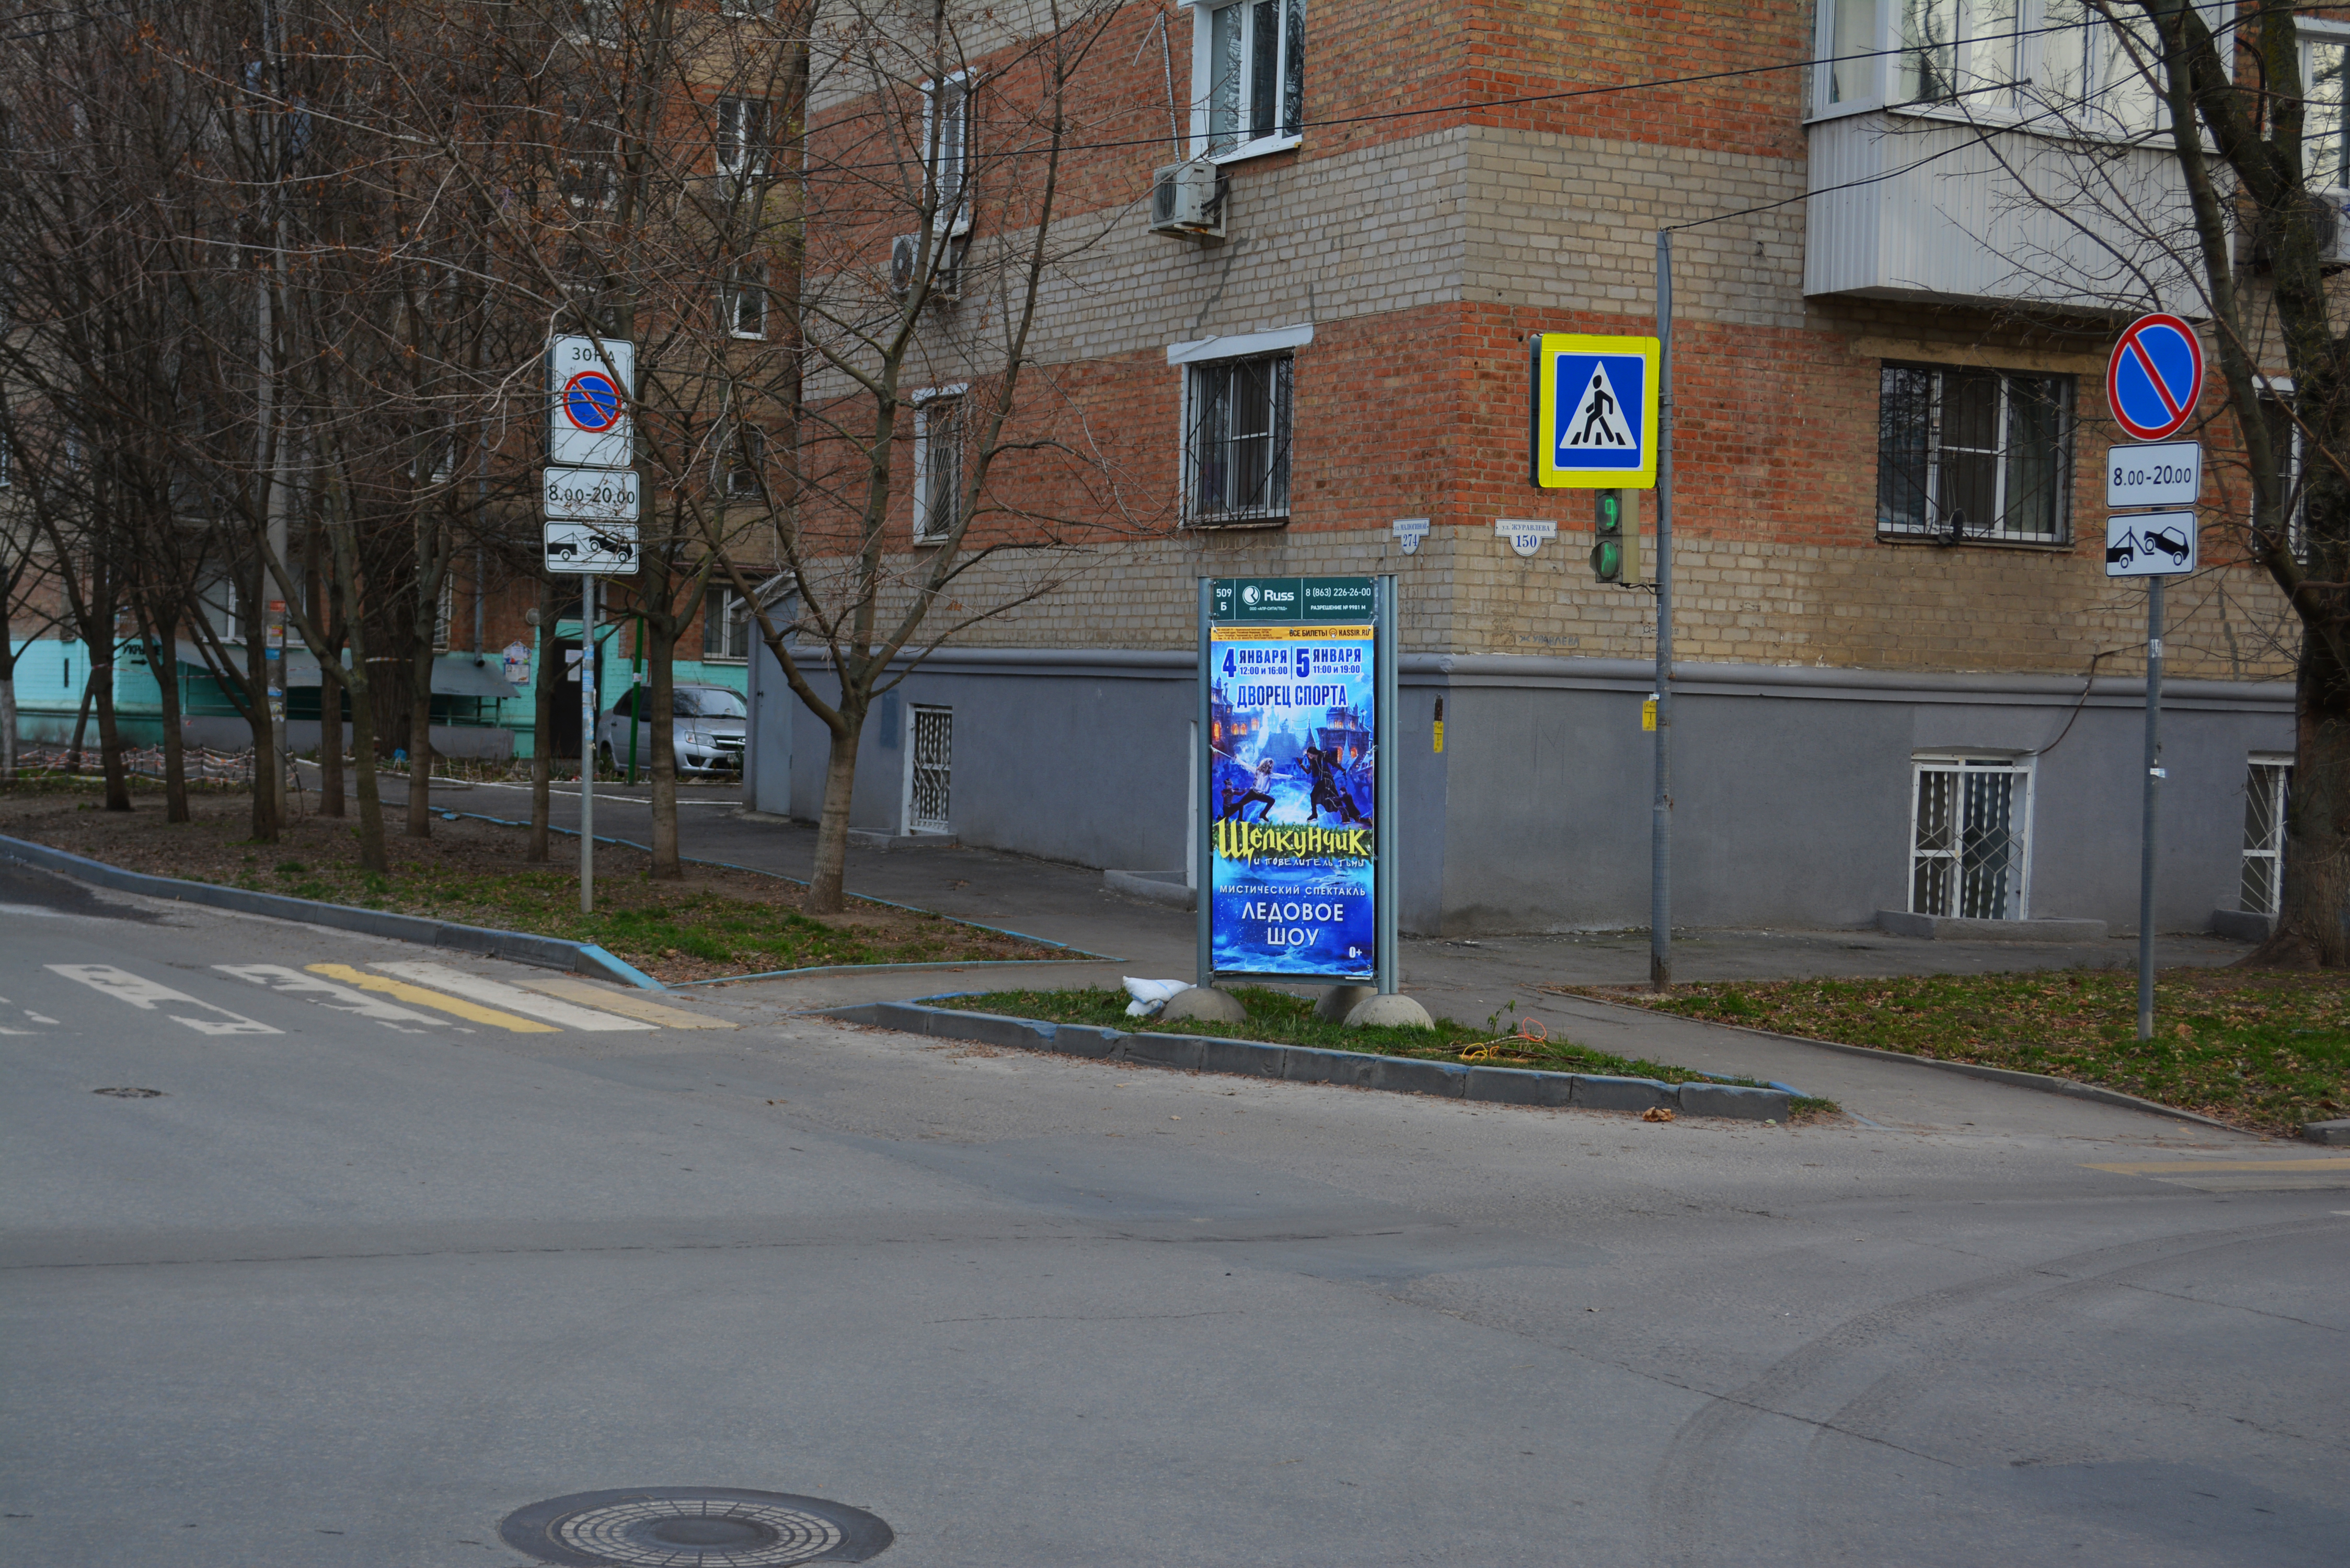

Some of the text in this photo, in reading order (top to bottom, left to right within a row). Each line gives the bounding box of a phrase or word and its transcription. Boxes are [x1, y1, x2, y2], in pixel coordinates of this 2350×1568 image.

[572, 347, 616, 363] ЗОНА
[2113, 465, 2192, 486] 8.00-20.00
[548, 485, 635, 504] 8.00-20.00
[1403, 534, 1417, 547] 274
[1516, 535, 1537, 548] 150
[1216, 589, 1232, 597] 509
[1264, 590, 1294, 601] Russ
[1312, 587, 1331, 597] (863)
[1333, 587, 1371, 596] 226-26-00
[1220, 602, 1227, 610] Б
[1223, 648, 1287, 677] 4 ЯНВАРЯ
[1296, 648, 1361, 677] 5 ЯНВАРЯ
[1340, 665, 1360, 673] 19:00
[1237, 685, 1347, 708] ДВОРЕЦ СПОРТА
[1213, 816, 1369, 868] Щелкунчик
[1264, 857, 1333, 867] ПОВЕЛИТЕЛЬ
[1338, 859, 1364, 867] ТЬМЫ
[1219, 885, 1366, 896] МИСТИЧЕСКИЙ СПЕКТАКЛЬ
[1242, 902, 1343, 923] ЛЕДОВОЕ
[1268, 927, 1319, 946] ШОУ
[1349, 947, 1362, 958] 0+
